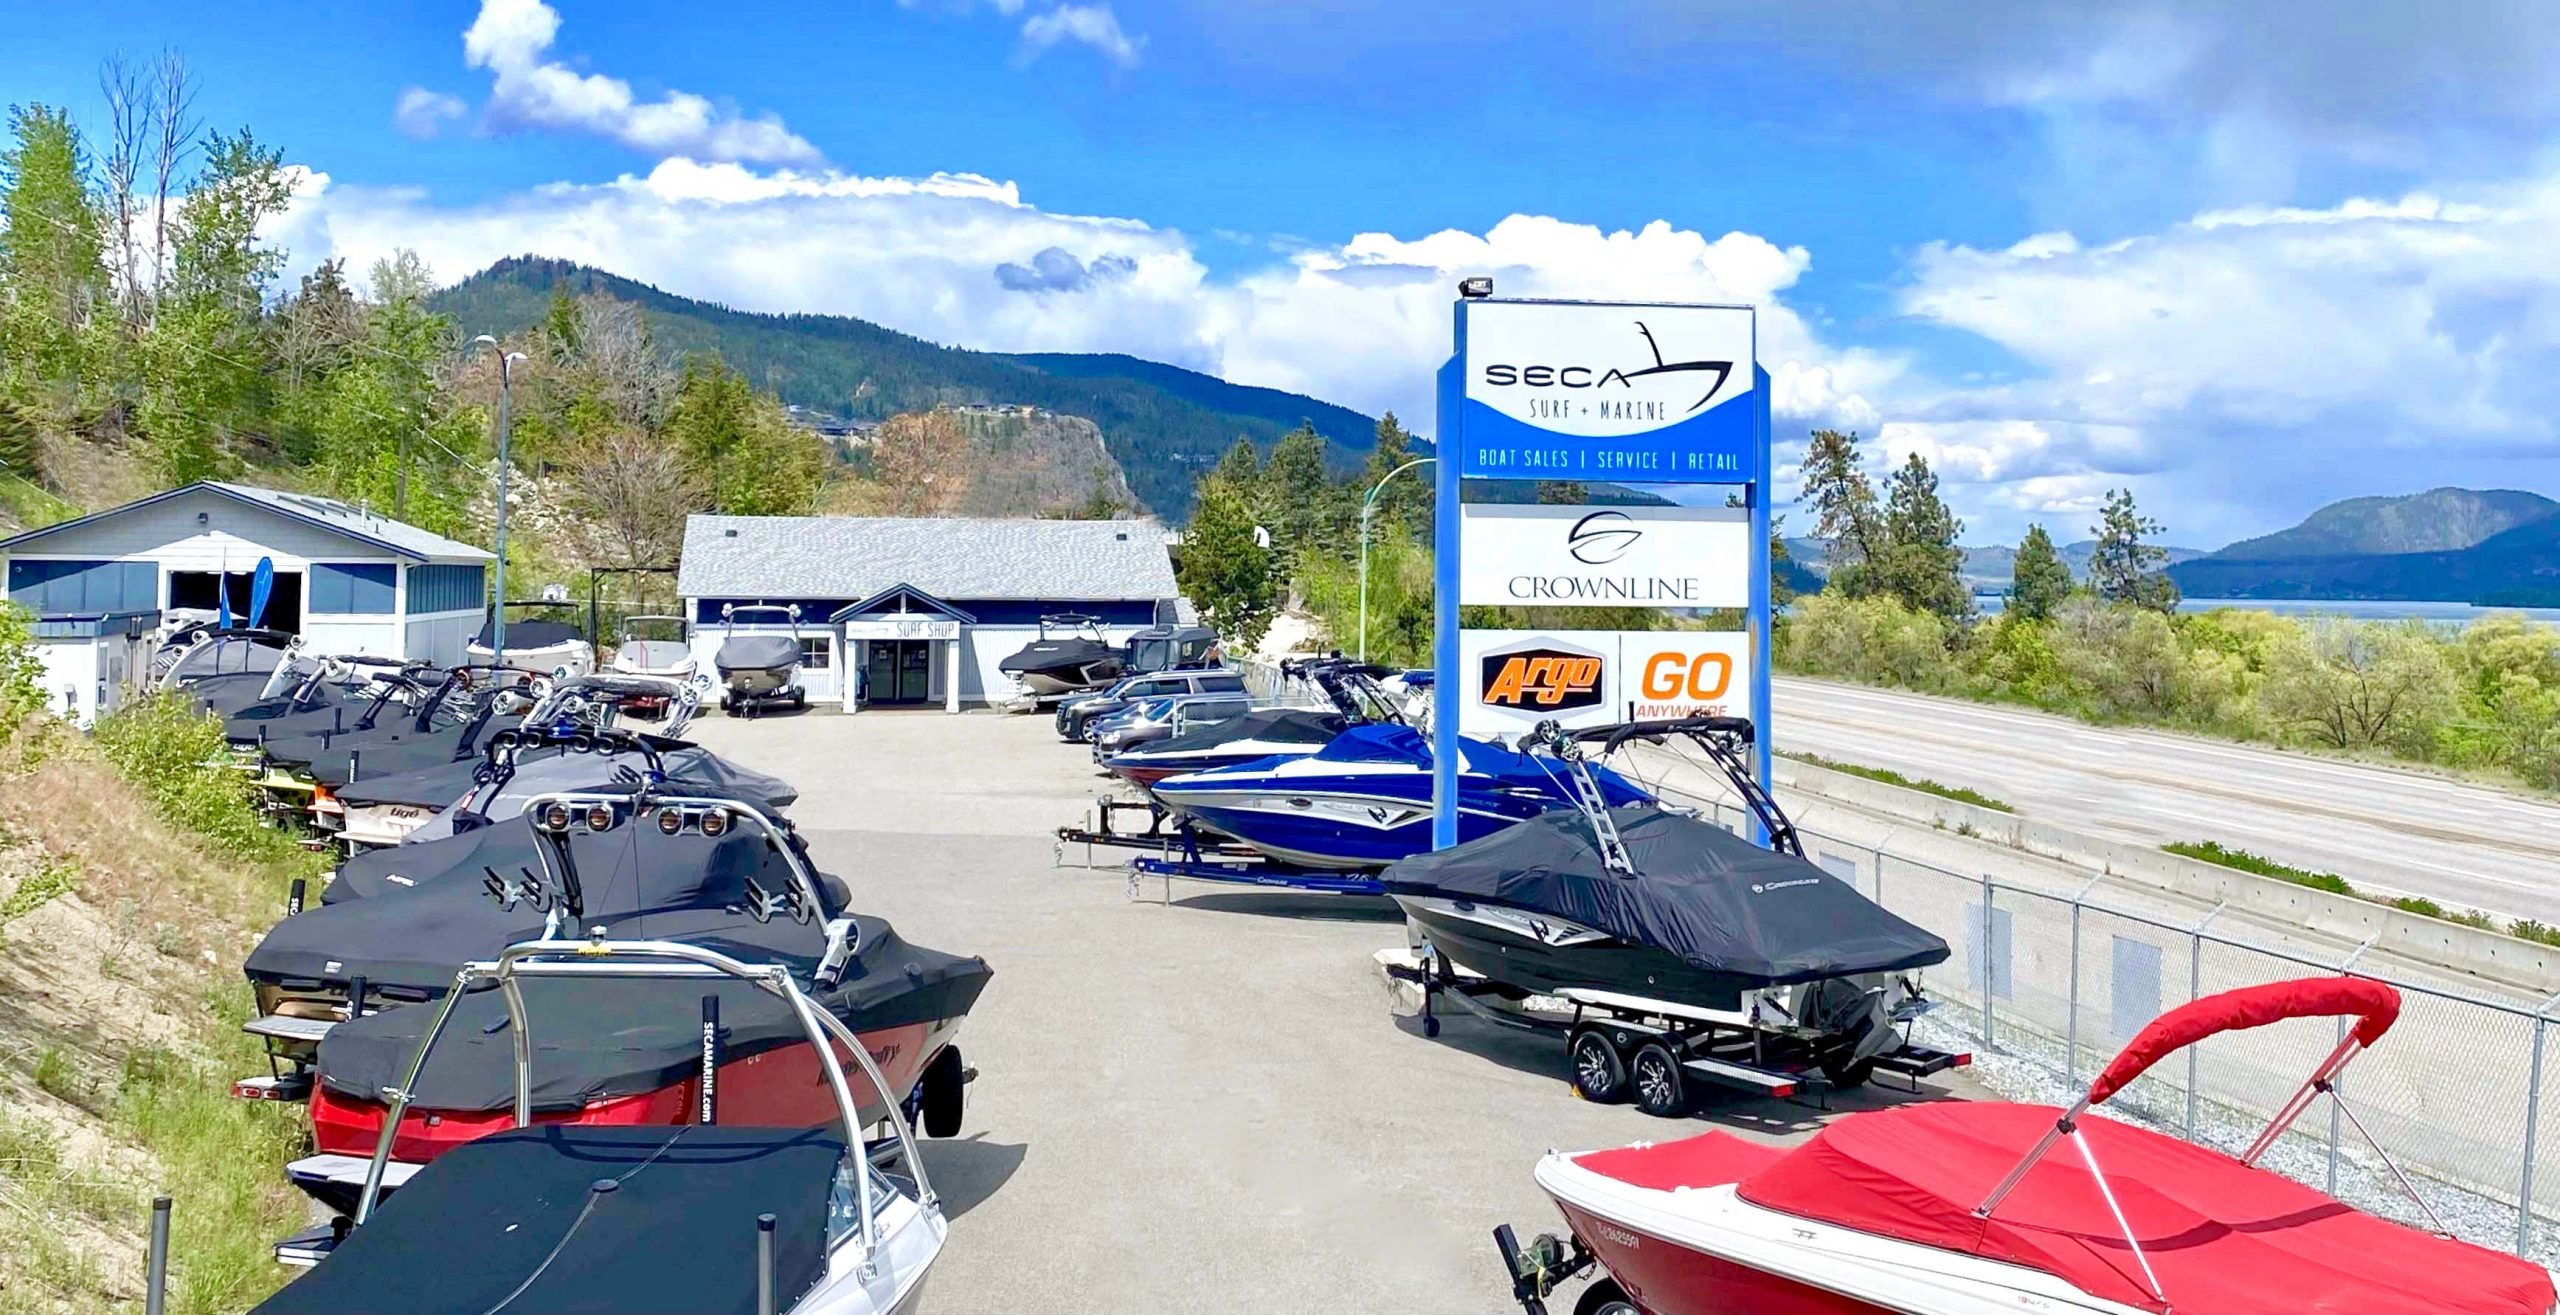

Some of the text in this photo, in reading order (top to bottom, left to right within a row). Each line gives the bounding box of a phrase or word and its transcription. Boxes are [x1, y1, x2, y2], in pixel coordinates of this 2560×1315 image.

[1485, 364, 1632, 388] SECA
[1529, 398, 1570, 419] SURF
[1600, 399, 1665, 421] MARINE
[1479, 448, 1516, 467] BOAT
[1524, 449, 1569, 468] SALES
[1597, 451, 1659, 469] SERVICE
[1688, 452, 1739, 471] RETAIL
[1508, 575, 1699, 600] CROWNLINE
[896, 622, 923, 638] SURF
[927, 622, 955, 638] SHOP
[1483, 656, 1602, 704] Argo
[1641, 652, 1733, 700] GO
[702, 1021, 714, 1123] SECAMARINE.com
